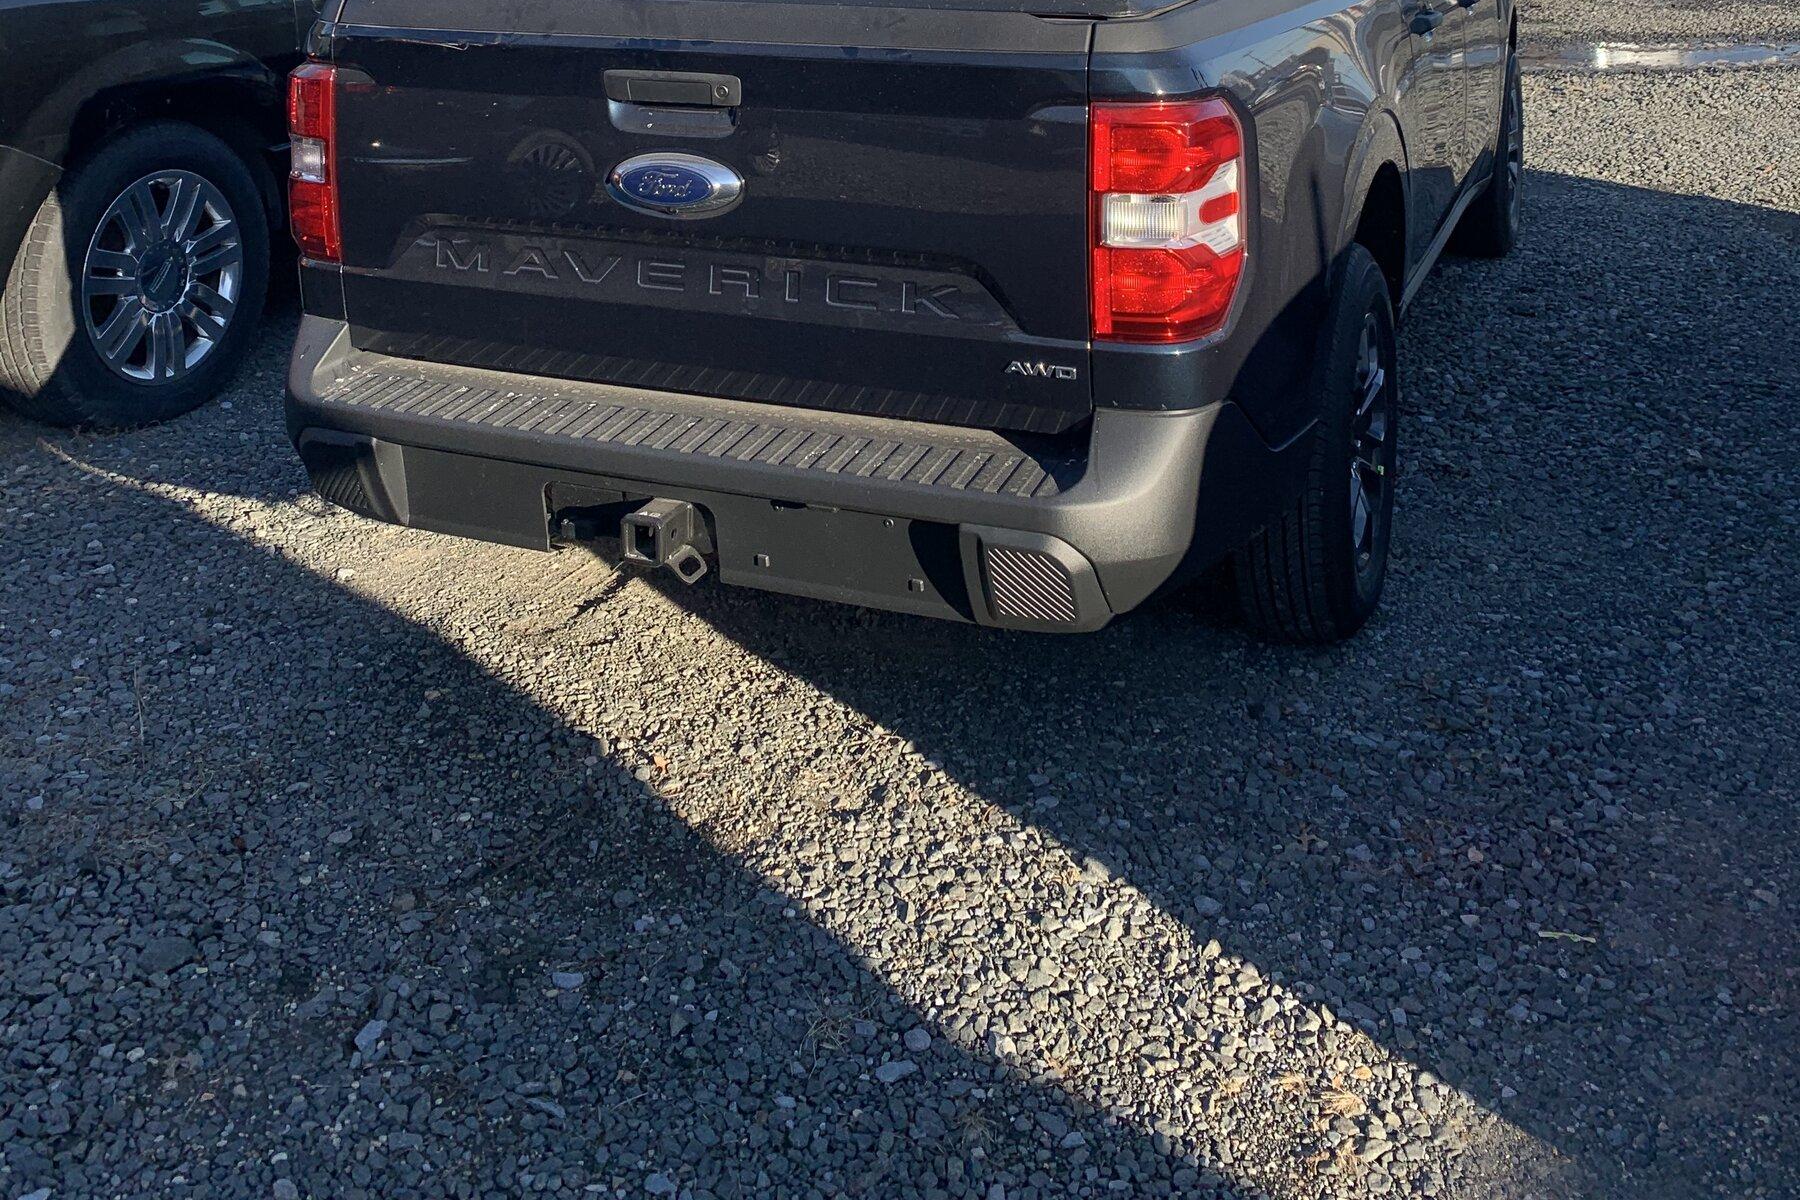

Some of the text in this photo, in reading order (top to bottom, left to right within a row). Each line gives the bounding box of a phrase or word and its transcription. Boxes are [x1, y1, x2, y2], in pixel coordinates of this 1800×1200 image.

[638, 171, 693, 197] Ford
[434, 238, 961, 319] MAVERICK
[1004, 360, 1077, 380] AWD
